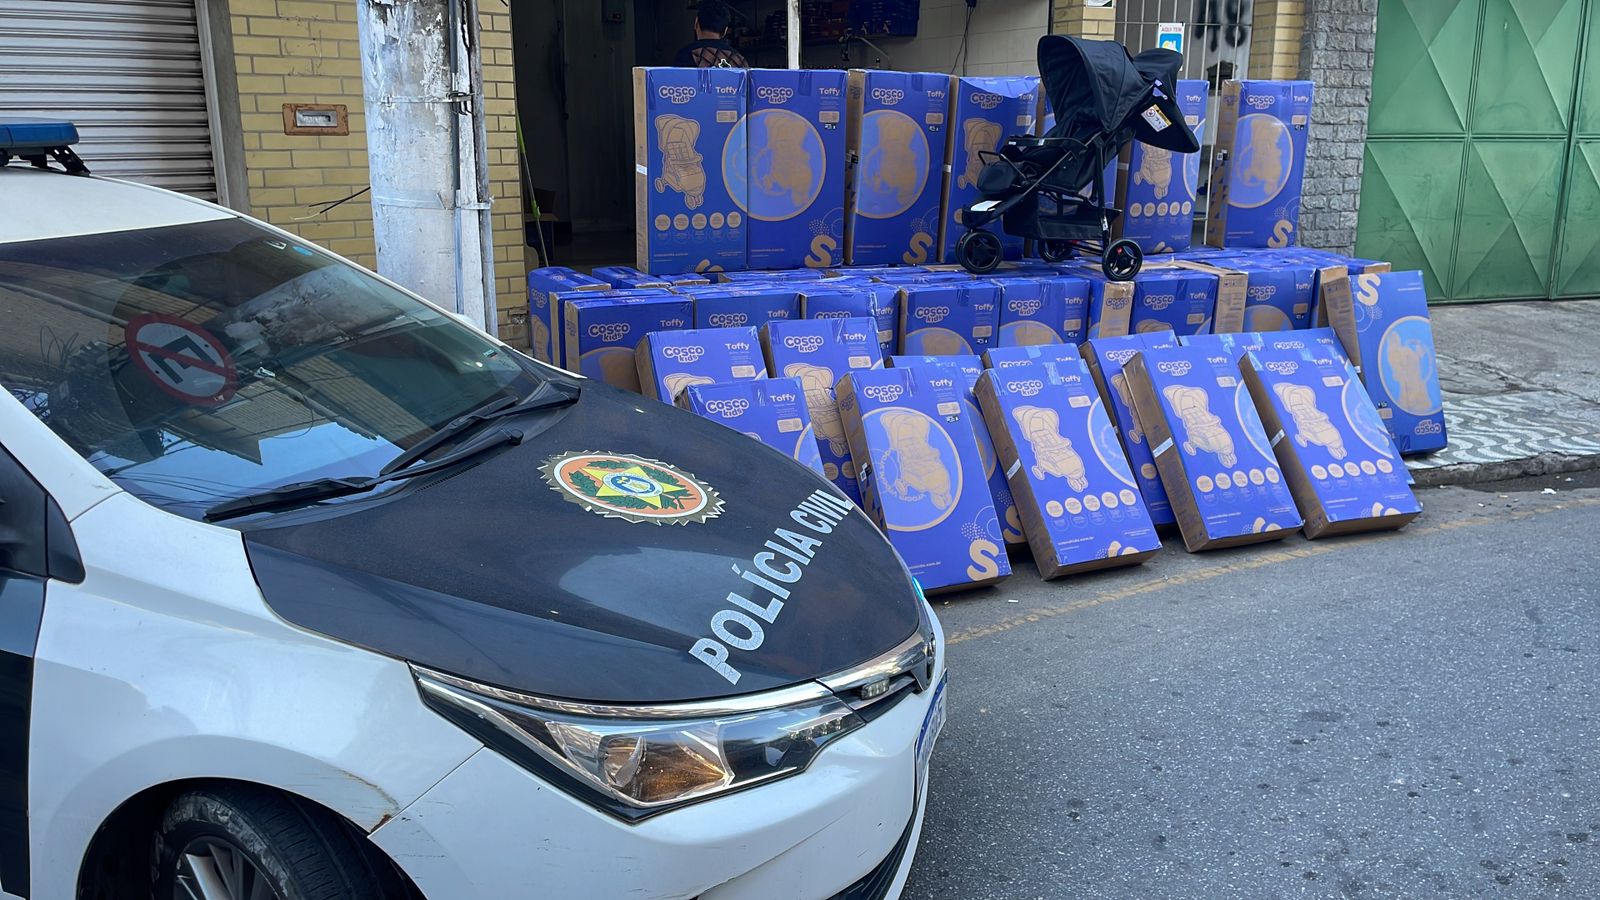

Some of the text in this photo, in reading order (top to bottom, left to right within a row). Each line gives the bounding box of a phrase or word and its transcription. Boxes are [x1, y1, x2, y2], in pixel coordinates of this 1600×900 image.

[716, 87, 738, 95] Toffy
[819, 88, 840, 96] Toffy
[1295, 283, 1311, 291] Toffy
[1190, 292, 1207, 300] Toffy
[1065, 297, 1083, 305] Toffy
[974, 304, 993, 312] Toffy
[768, 310, 789, 319] Toffy
[661, 318, 684, 328] Toffy
[844, 332, 867, 342] Toffy
[725, 342, 750, 351] Toffy
[1206, 357, 1228, 365] Toffy
[930, 379, 953, 387] Toffy
[769, 394, 796, 403] Toffy
[688, 488, 854, 685] POLÍCIA CIVIL
